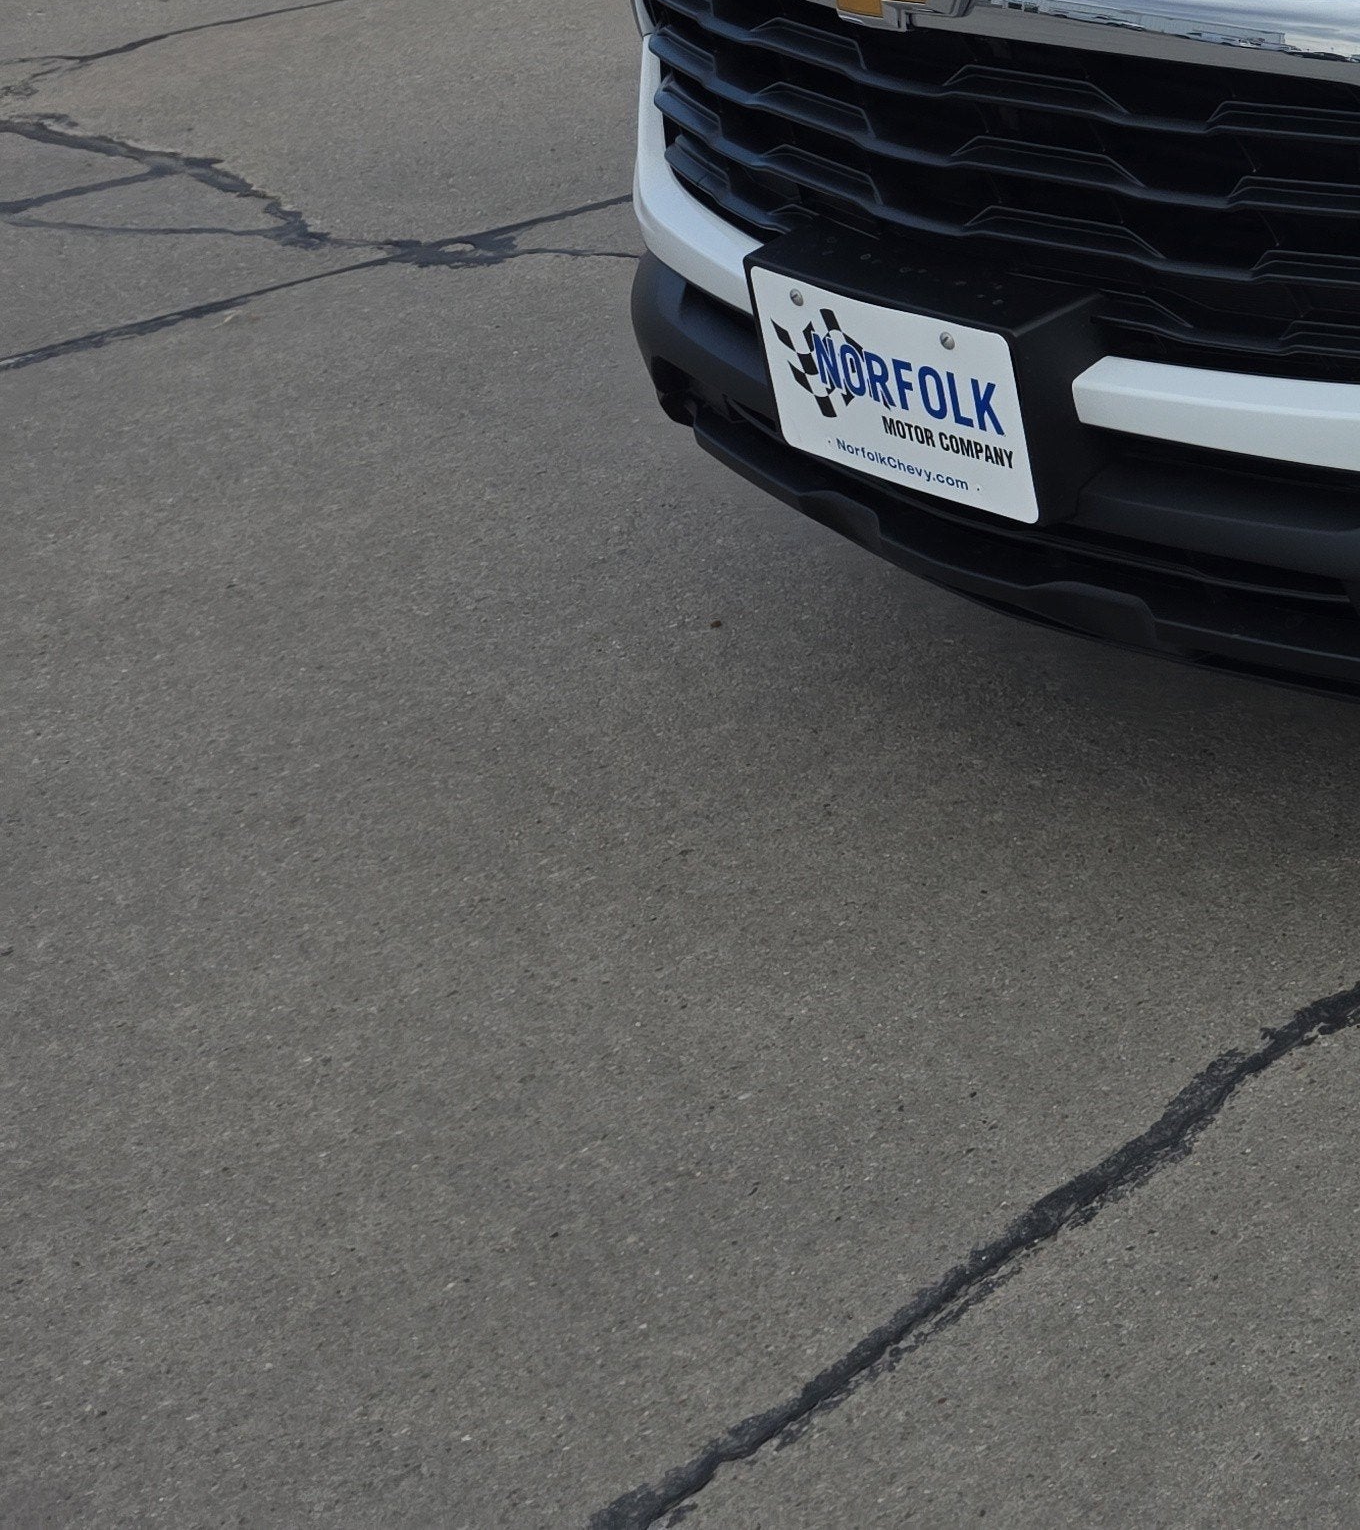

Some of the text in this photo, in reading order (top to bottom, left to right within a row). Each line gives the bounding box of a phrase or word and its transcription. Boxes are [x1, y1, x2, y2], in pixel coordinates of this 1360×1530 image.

[812, 332, 1006, 437] NORFOLK
[836, 437, 969, 491] NorfolkChevy.com
[881, 415, 1014, 469] MOTOR COMPANY
